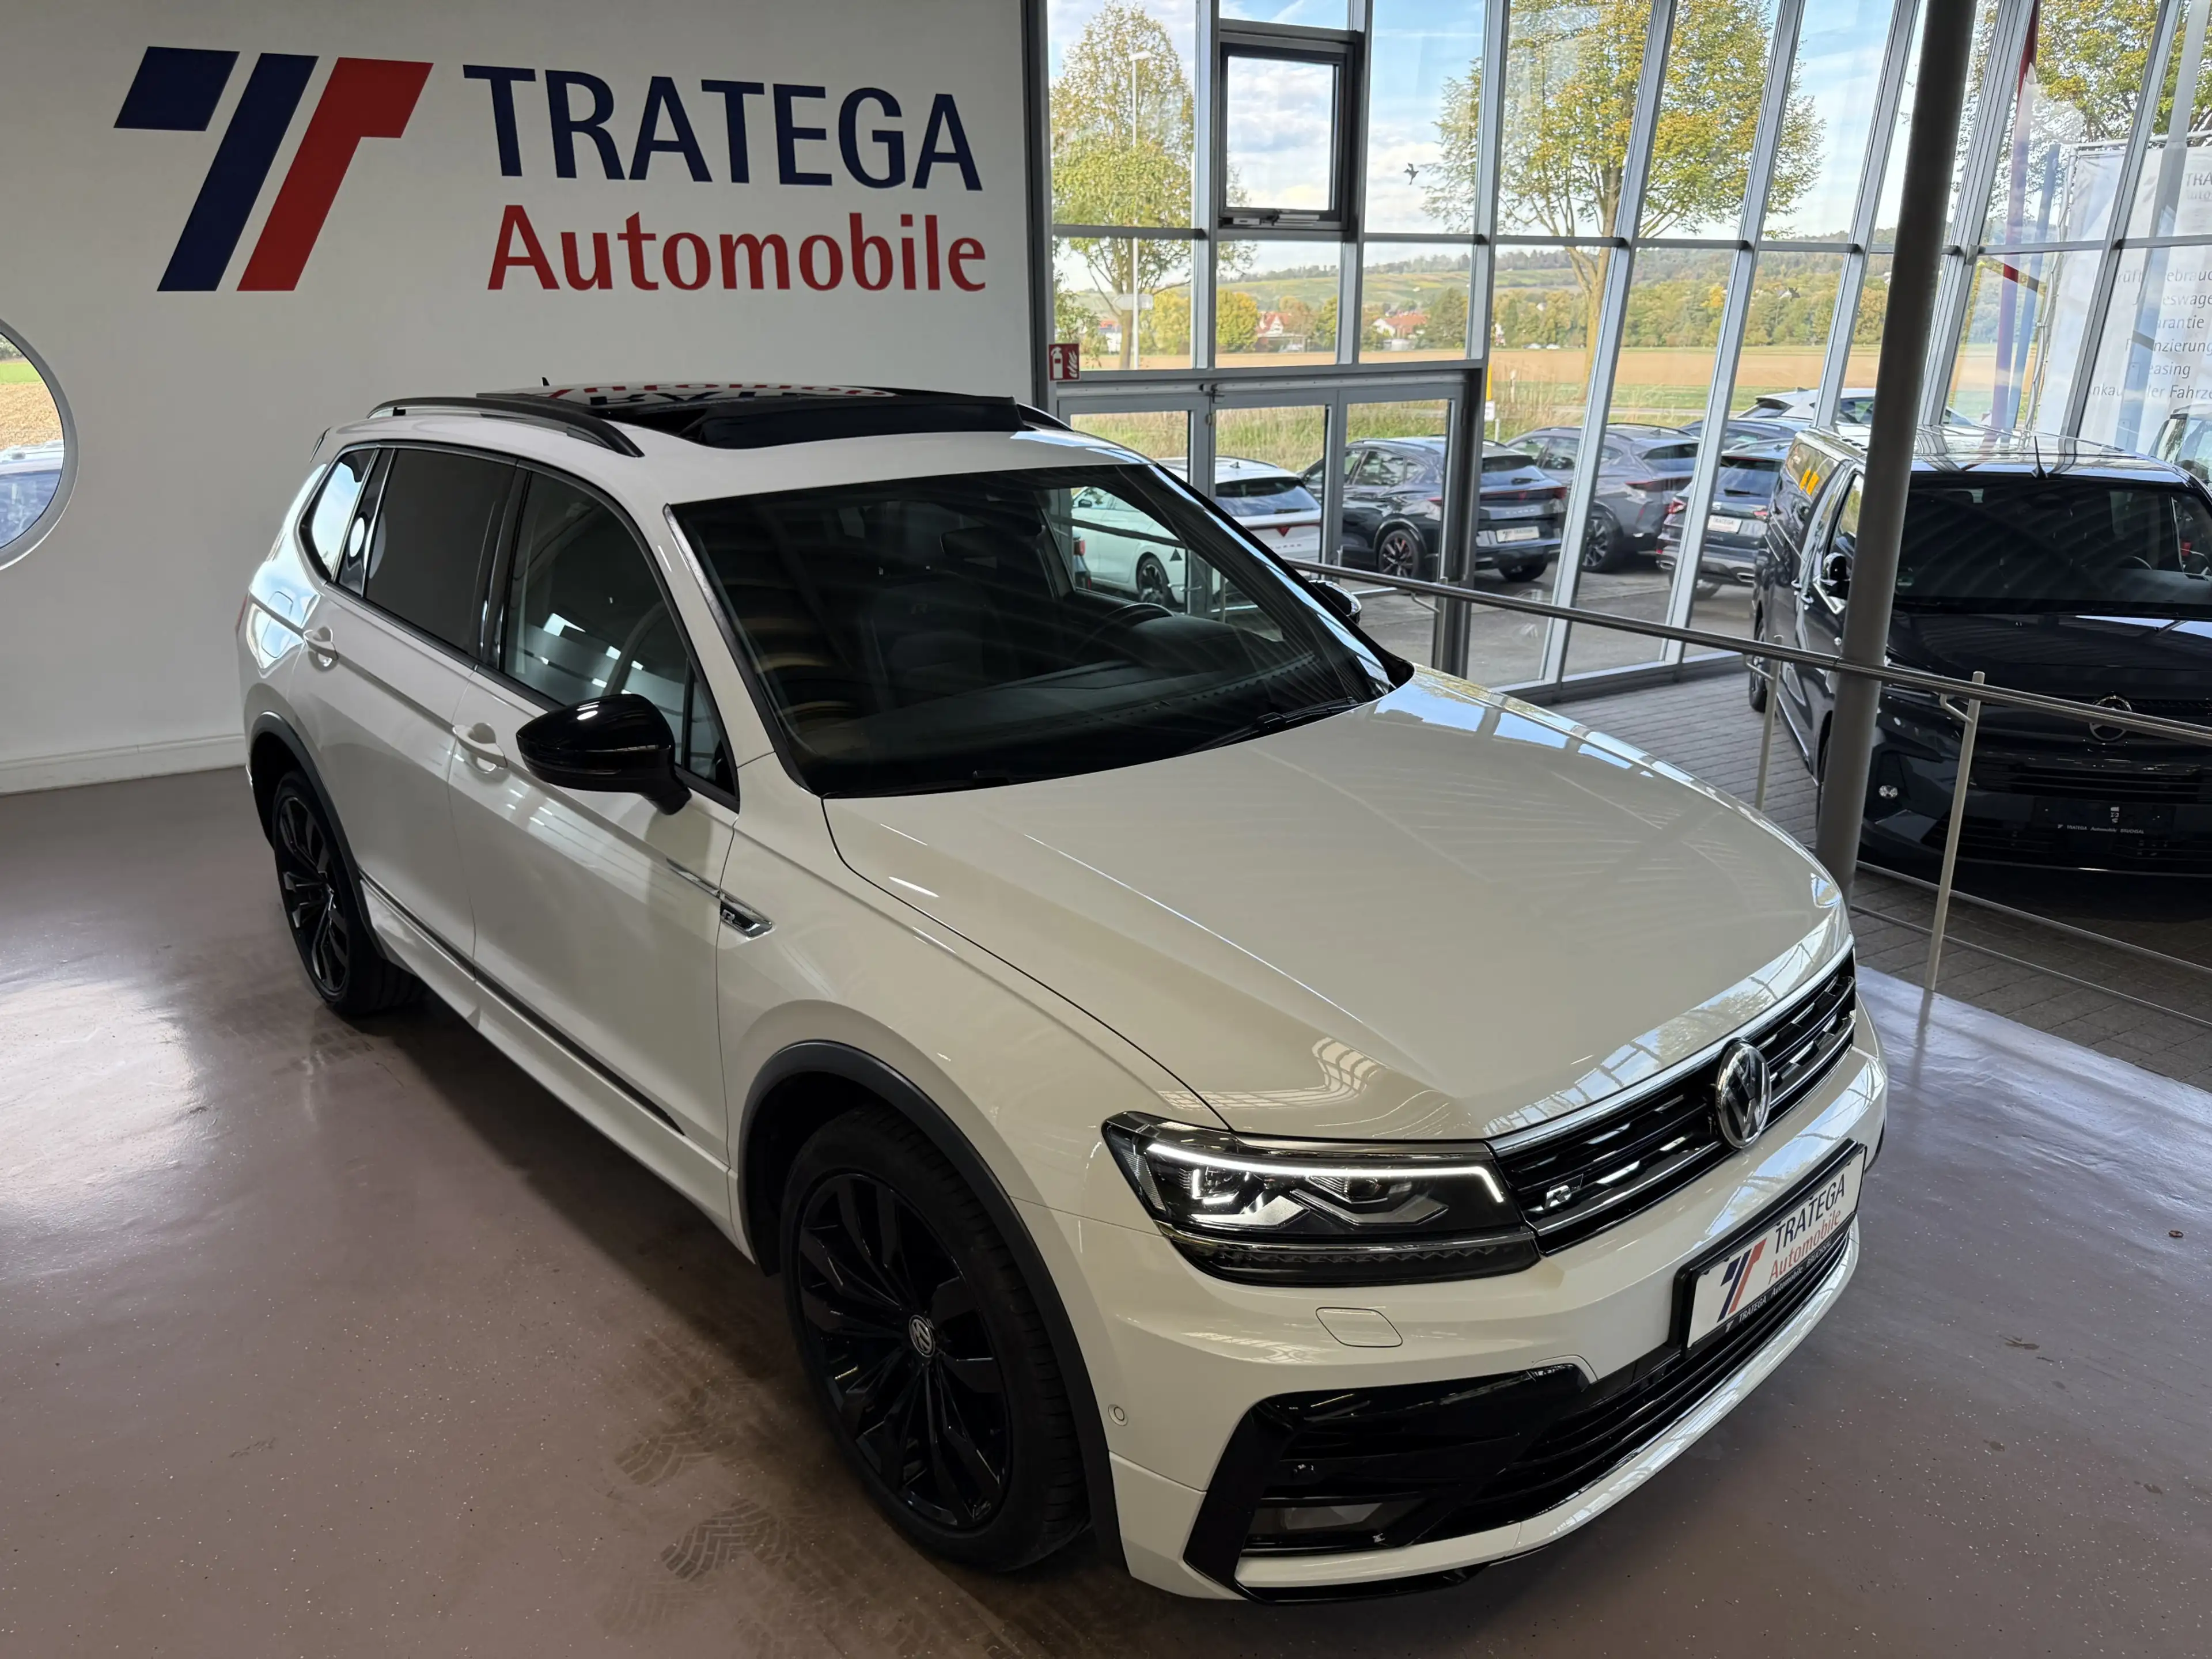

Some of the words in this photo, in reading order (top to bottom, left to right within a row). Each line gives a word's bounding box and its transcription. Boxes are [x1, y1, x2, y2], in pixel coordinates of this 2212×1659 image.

[463, 65, 983, 191] TRATEGA
[487, 204, 986, 292] Automobile
[1768, 1209, 1841, 1285] Automobile
[1775, 1173, 1844, 1254] TRATEGA
[1739, 1296, 1767, 1322] TRATEGA
